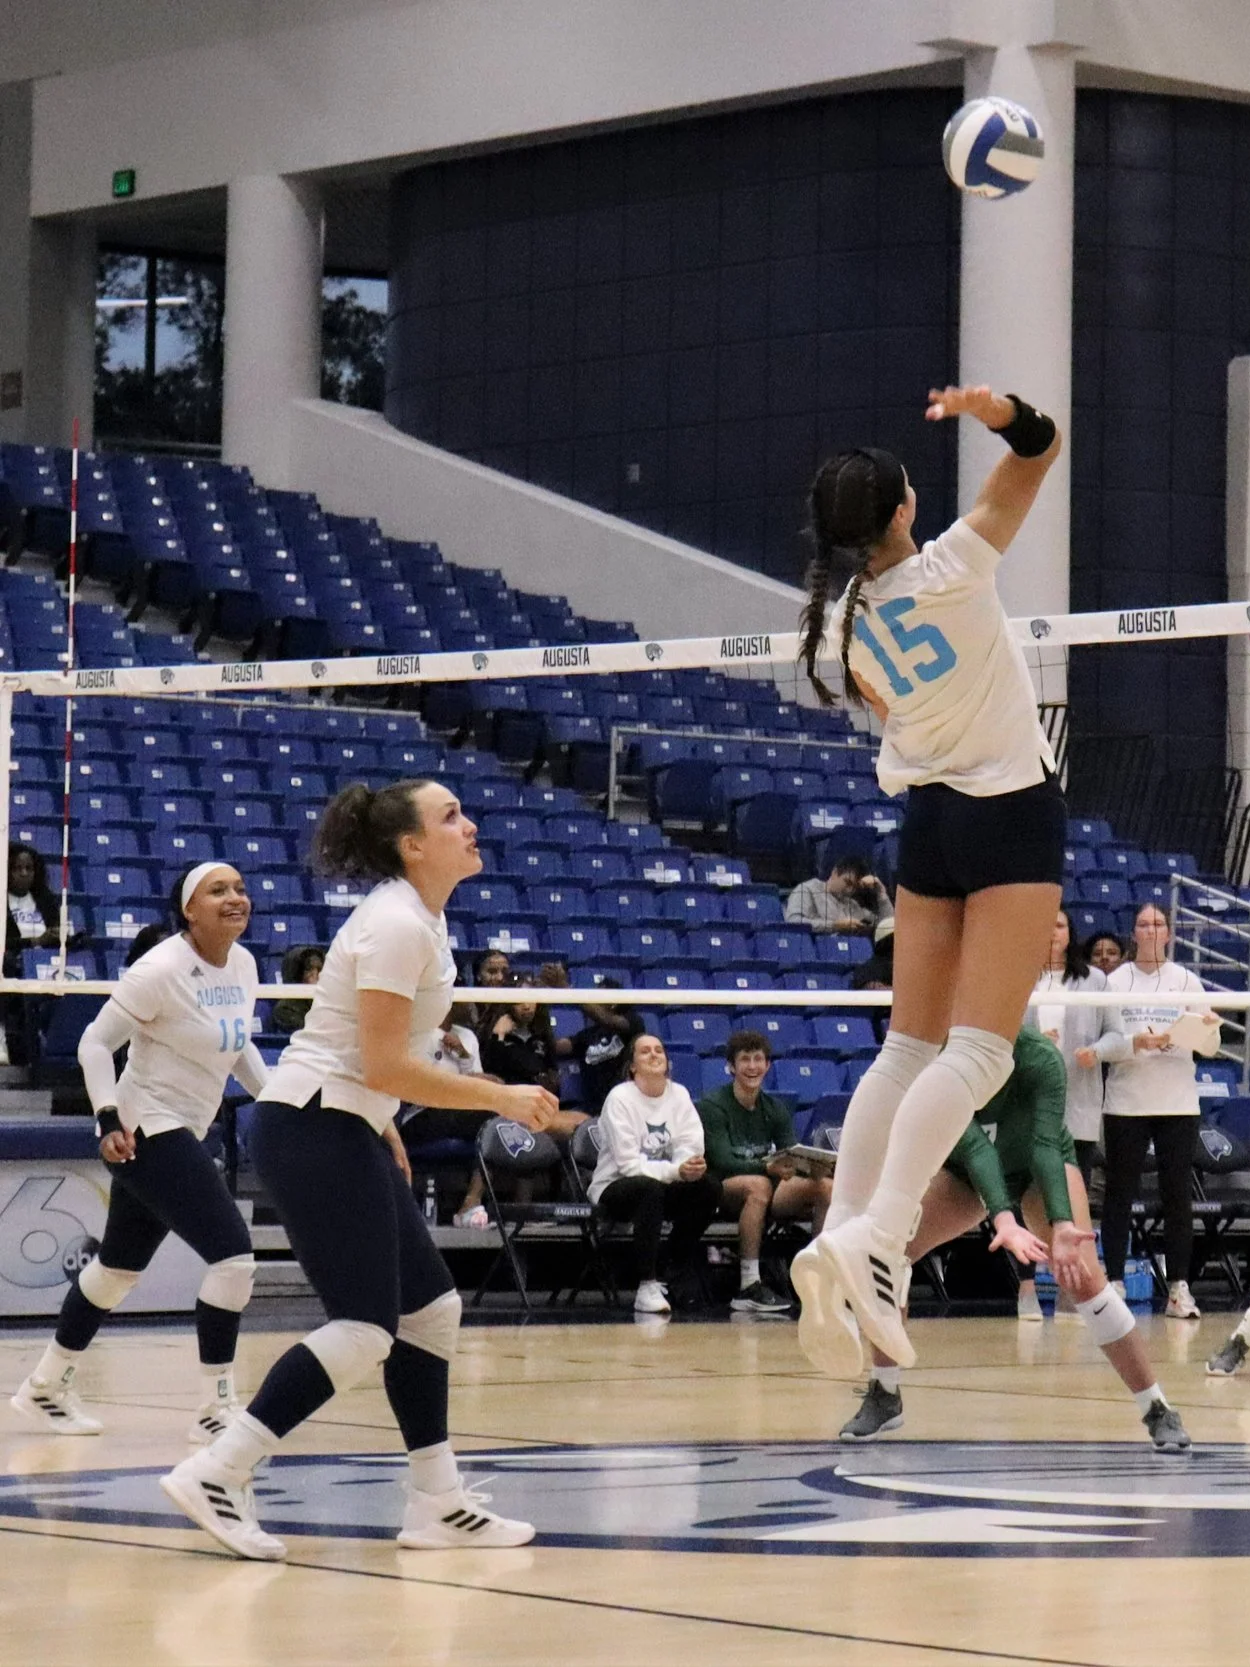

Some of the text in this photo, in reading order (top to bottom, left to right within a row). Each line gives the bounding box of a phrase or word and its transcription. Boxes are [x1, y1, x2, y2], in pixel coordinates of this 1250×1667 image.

[1117, 611, 1178, 635] AUGUSTA
[542, 646, 591, 670] AUGUSTA
[720, 635, 771, 658] AUGUSTA
[854, 596, 957, 697] 15
[221, 664, 264, 683] AUGUSTA
[376, 655, 421, 677] AUGUSTA
[75, 670, 116, 689] AUGUSTA
[197, 986, 246, 1008] AUGUST
[219, 1018, 246, 1053] 16
[63, 1248, 93, 1272] ab
